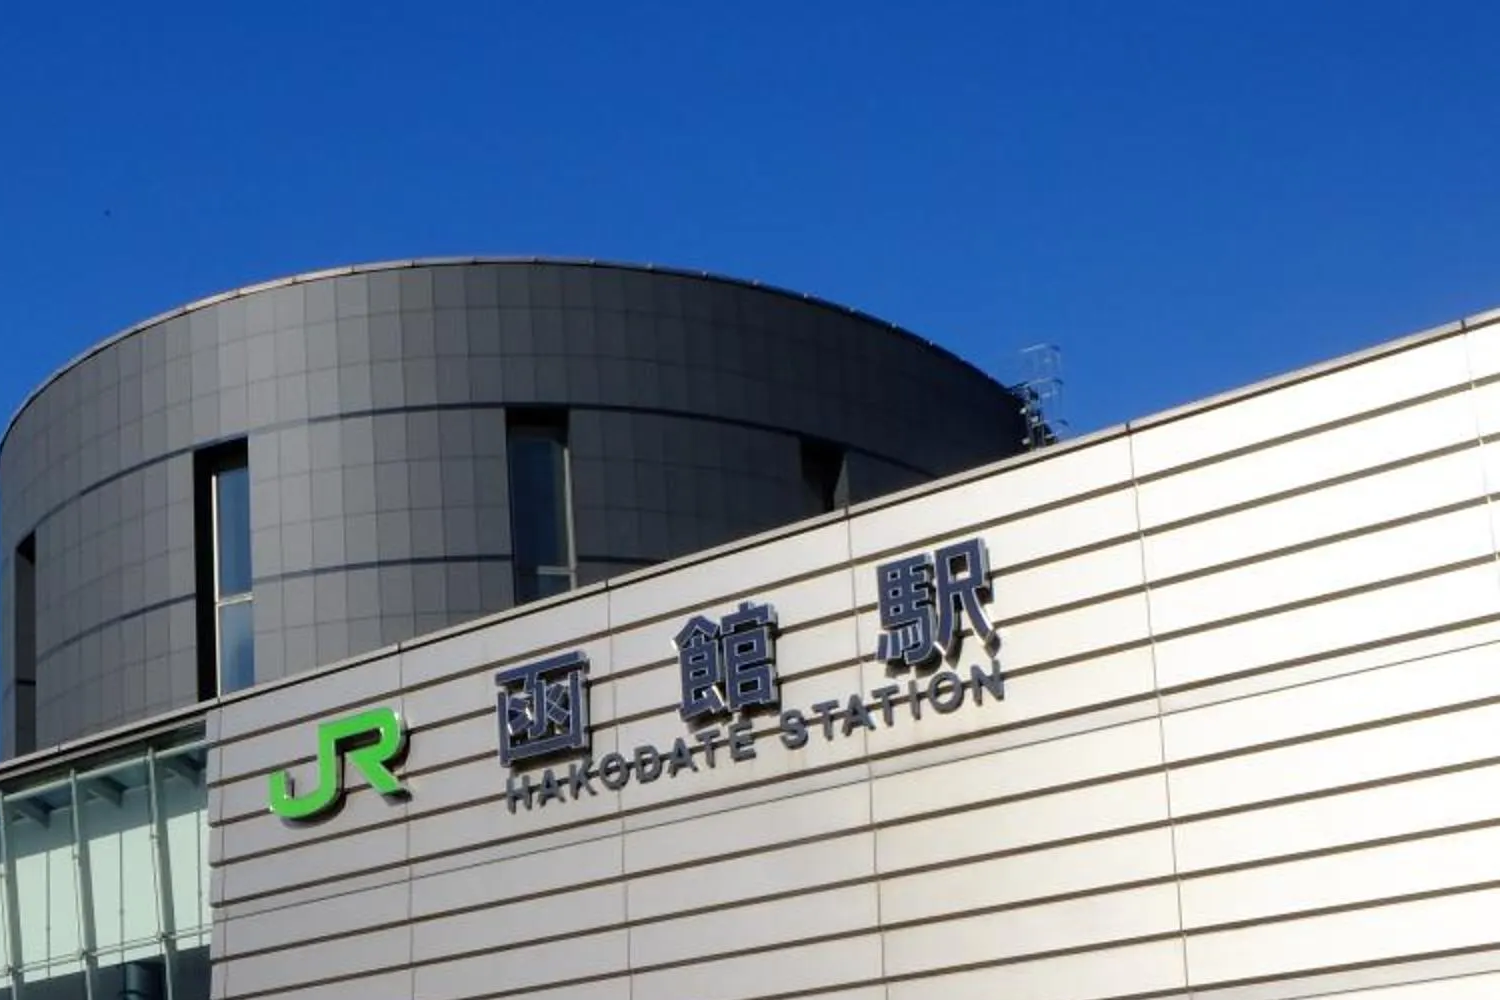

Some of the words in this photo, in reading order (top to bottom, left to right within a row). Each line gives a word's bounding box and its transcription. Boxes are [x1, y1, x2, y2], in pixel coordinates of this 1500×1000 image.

[494, 537, 1002, 770] 函館駅
[269, 706, 411, 820] JR
[505, 722, 758, 814] HAKODATE
[779, 658, 1006, 750] STATION
